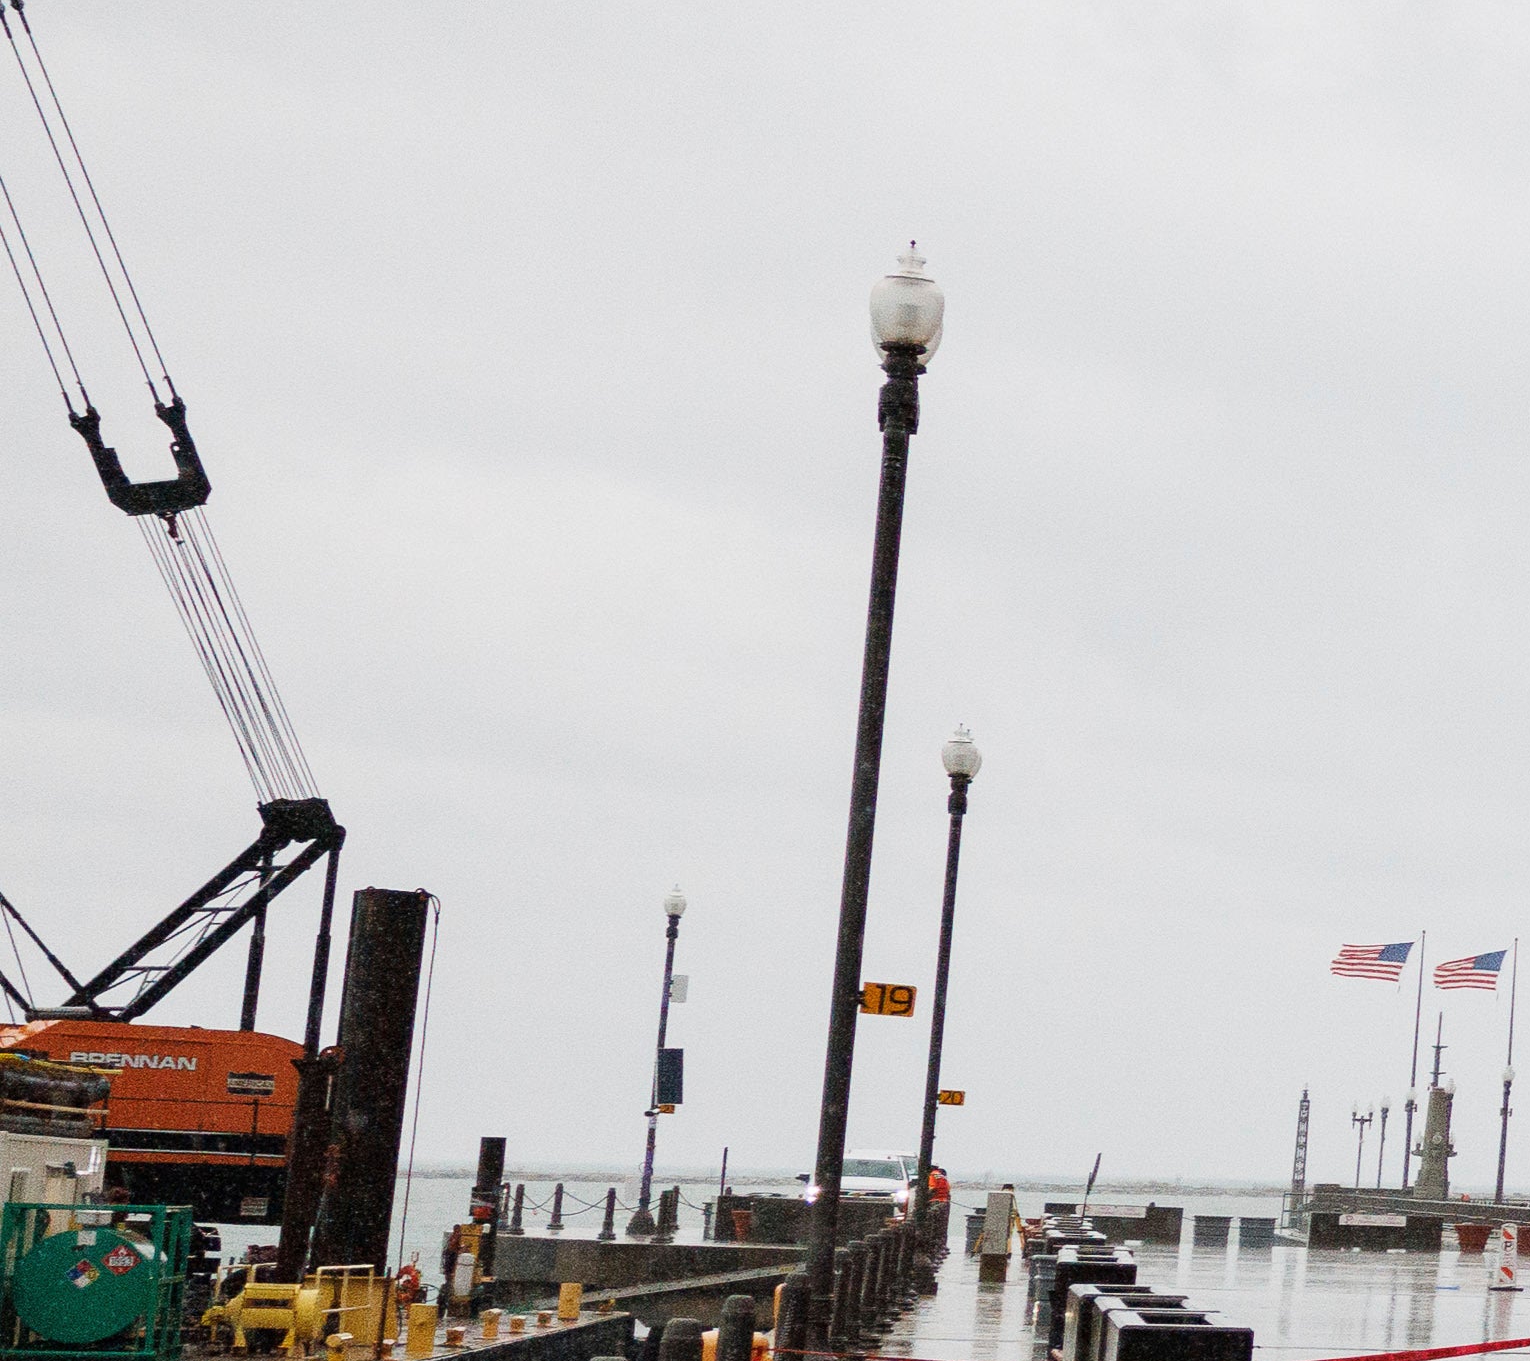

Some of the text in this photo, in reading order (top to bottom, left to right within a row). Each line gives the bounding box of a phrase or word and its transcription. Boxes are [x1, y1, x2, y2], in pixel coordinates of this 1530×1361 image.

[876, 984, 914, 1015] 19
[70, 1051, 198, 1071] BRENNAN
[942, 1090, 963, 1105] 20
